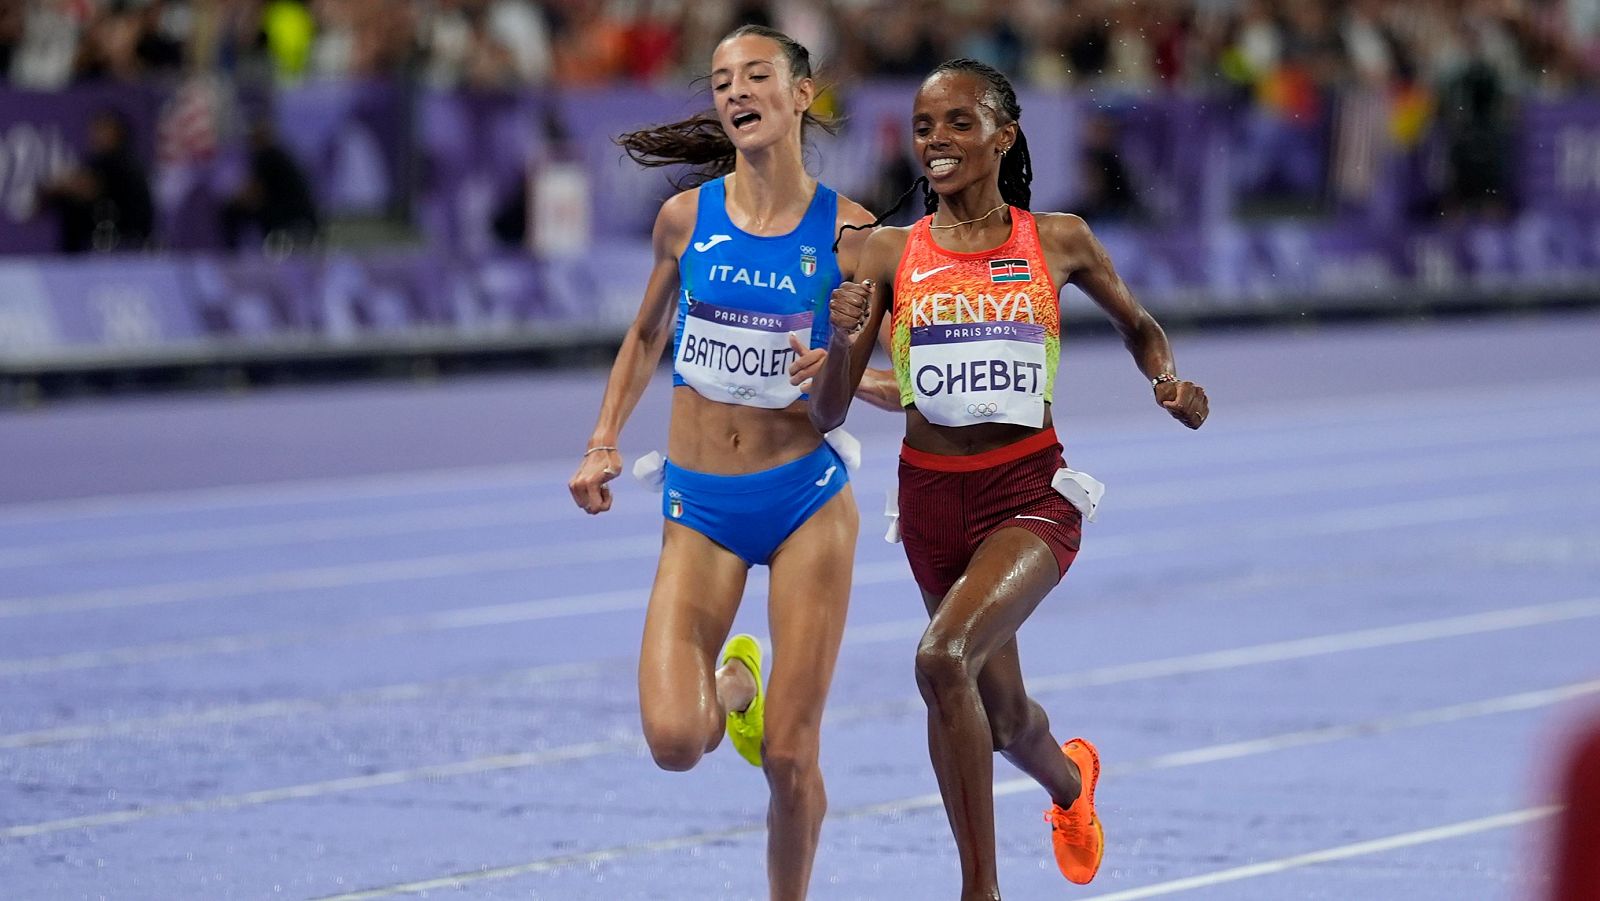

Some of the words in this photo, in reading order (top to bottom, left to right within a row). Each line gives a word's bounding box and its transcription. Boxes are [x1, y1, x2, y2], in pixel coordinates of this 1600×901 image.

[709, 265, 796, 293] ITALIA
[714, 310, 749, 324] PARIS
[752, 316, 782, 328] 2024
[912, 293, 1034, 326] KENYA
[945, 327, 981, 339] PARIS
[985, 326, 1017, 336] 2024
[916, 359, 1042, 396] CHEBET
